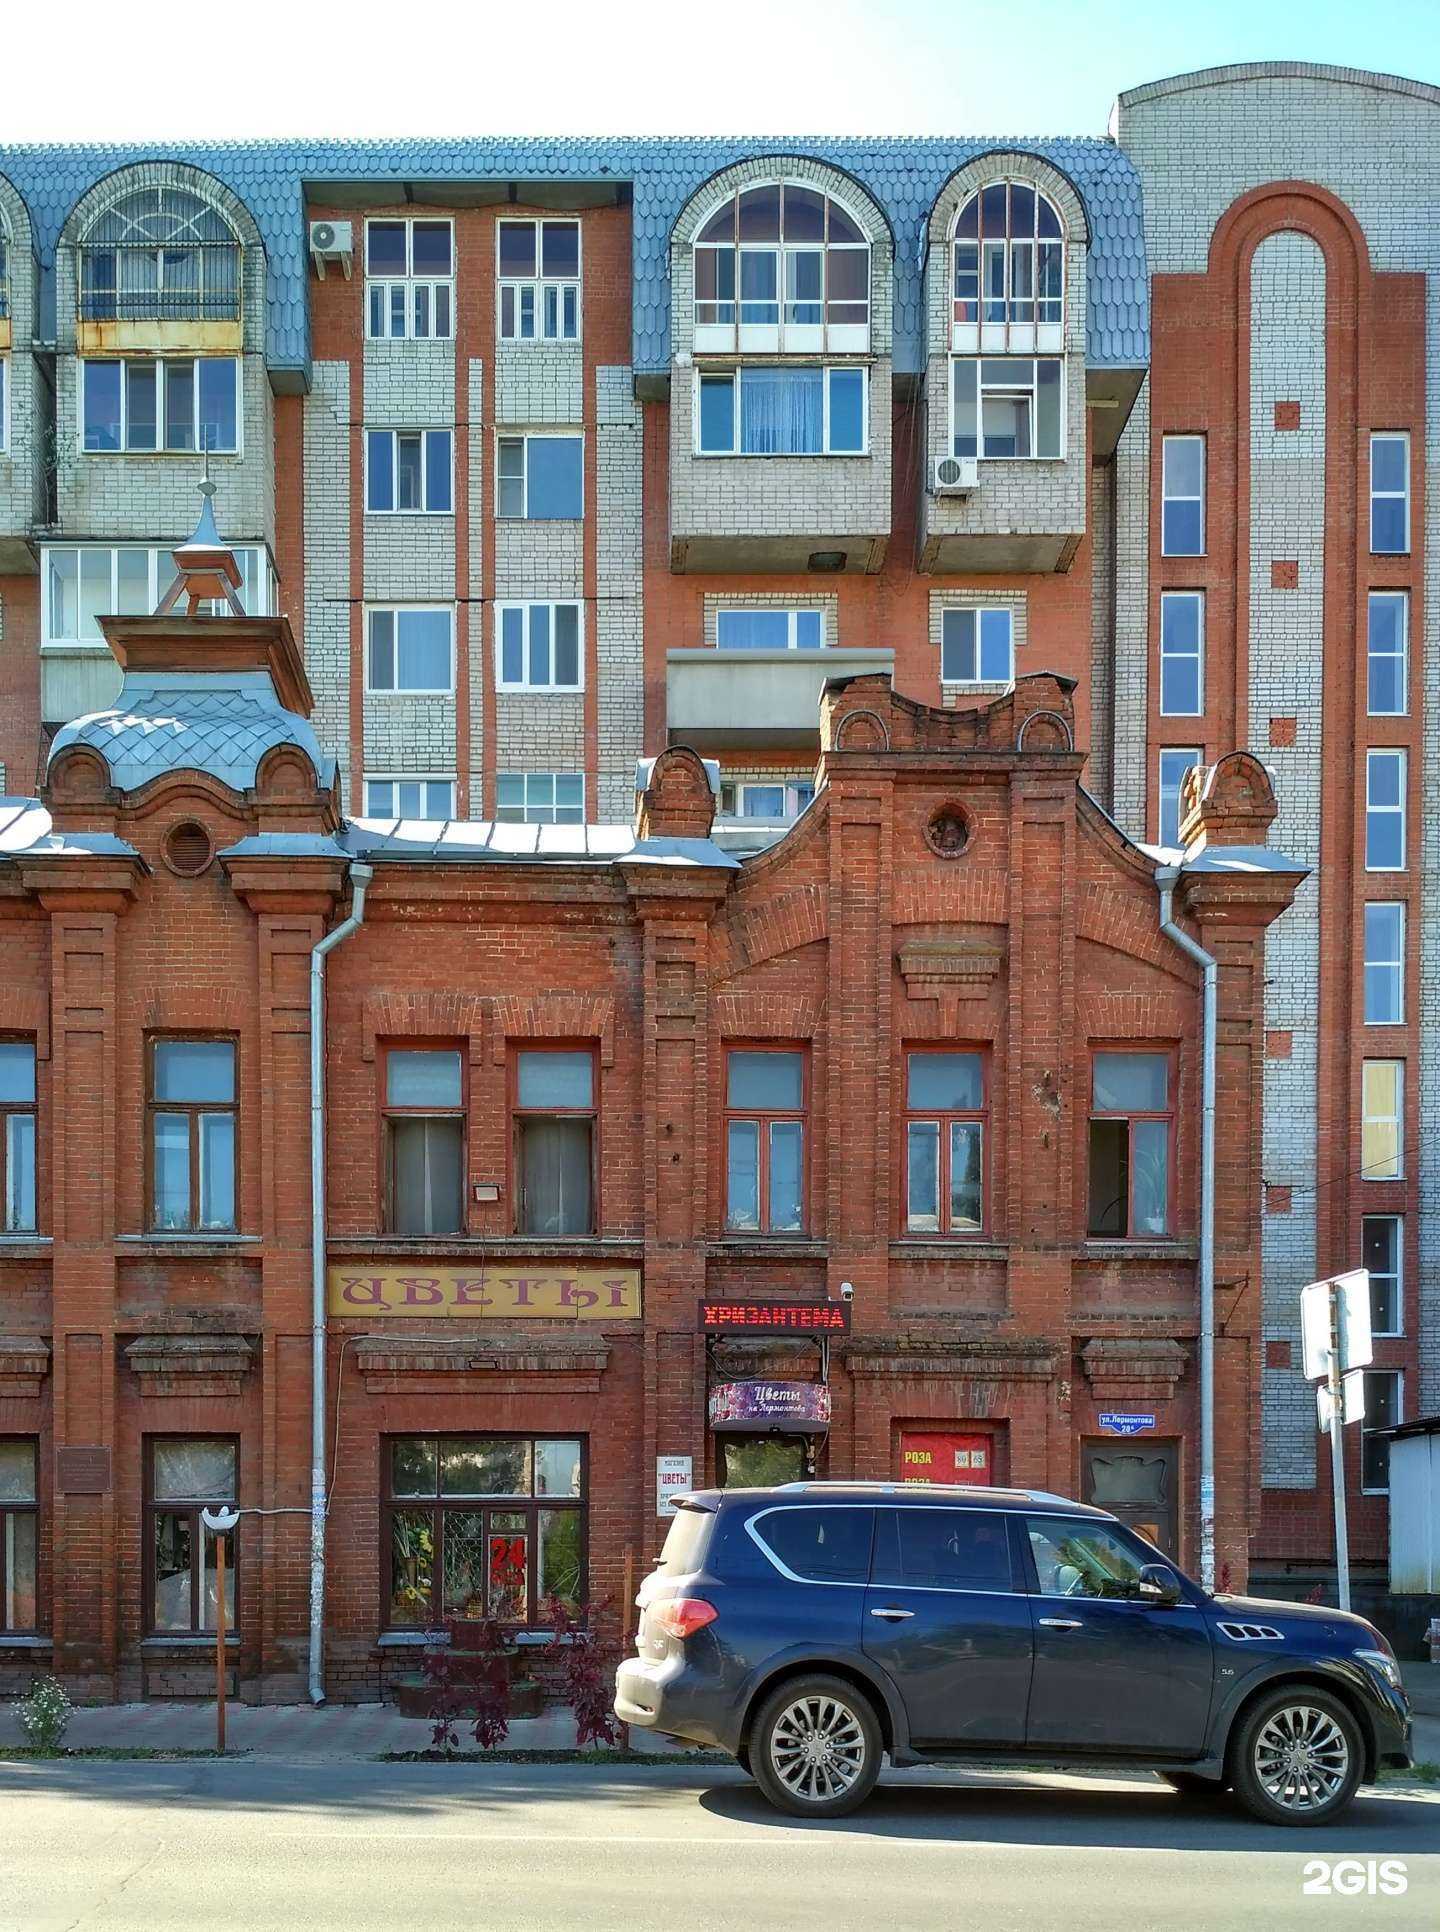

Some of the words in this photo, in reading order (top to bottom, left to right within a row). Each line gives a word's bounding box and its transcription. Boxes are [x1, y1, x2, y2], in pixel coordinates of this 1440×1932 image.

[340, 1277, 628, 1311] ЦВЕТЫ
[704, 1306, 845, 1328] ХРИЗАНТЕМА
[754, 1386, 801, 1404] Цветы
[904, 1451, 932, 1464] РОЗА
[491, 1537, 526, 1570] 24
